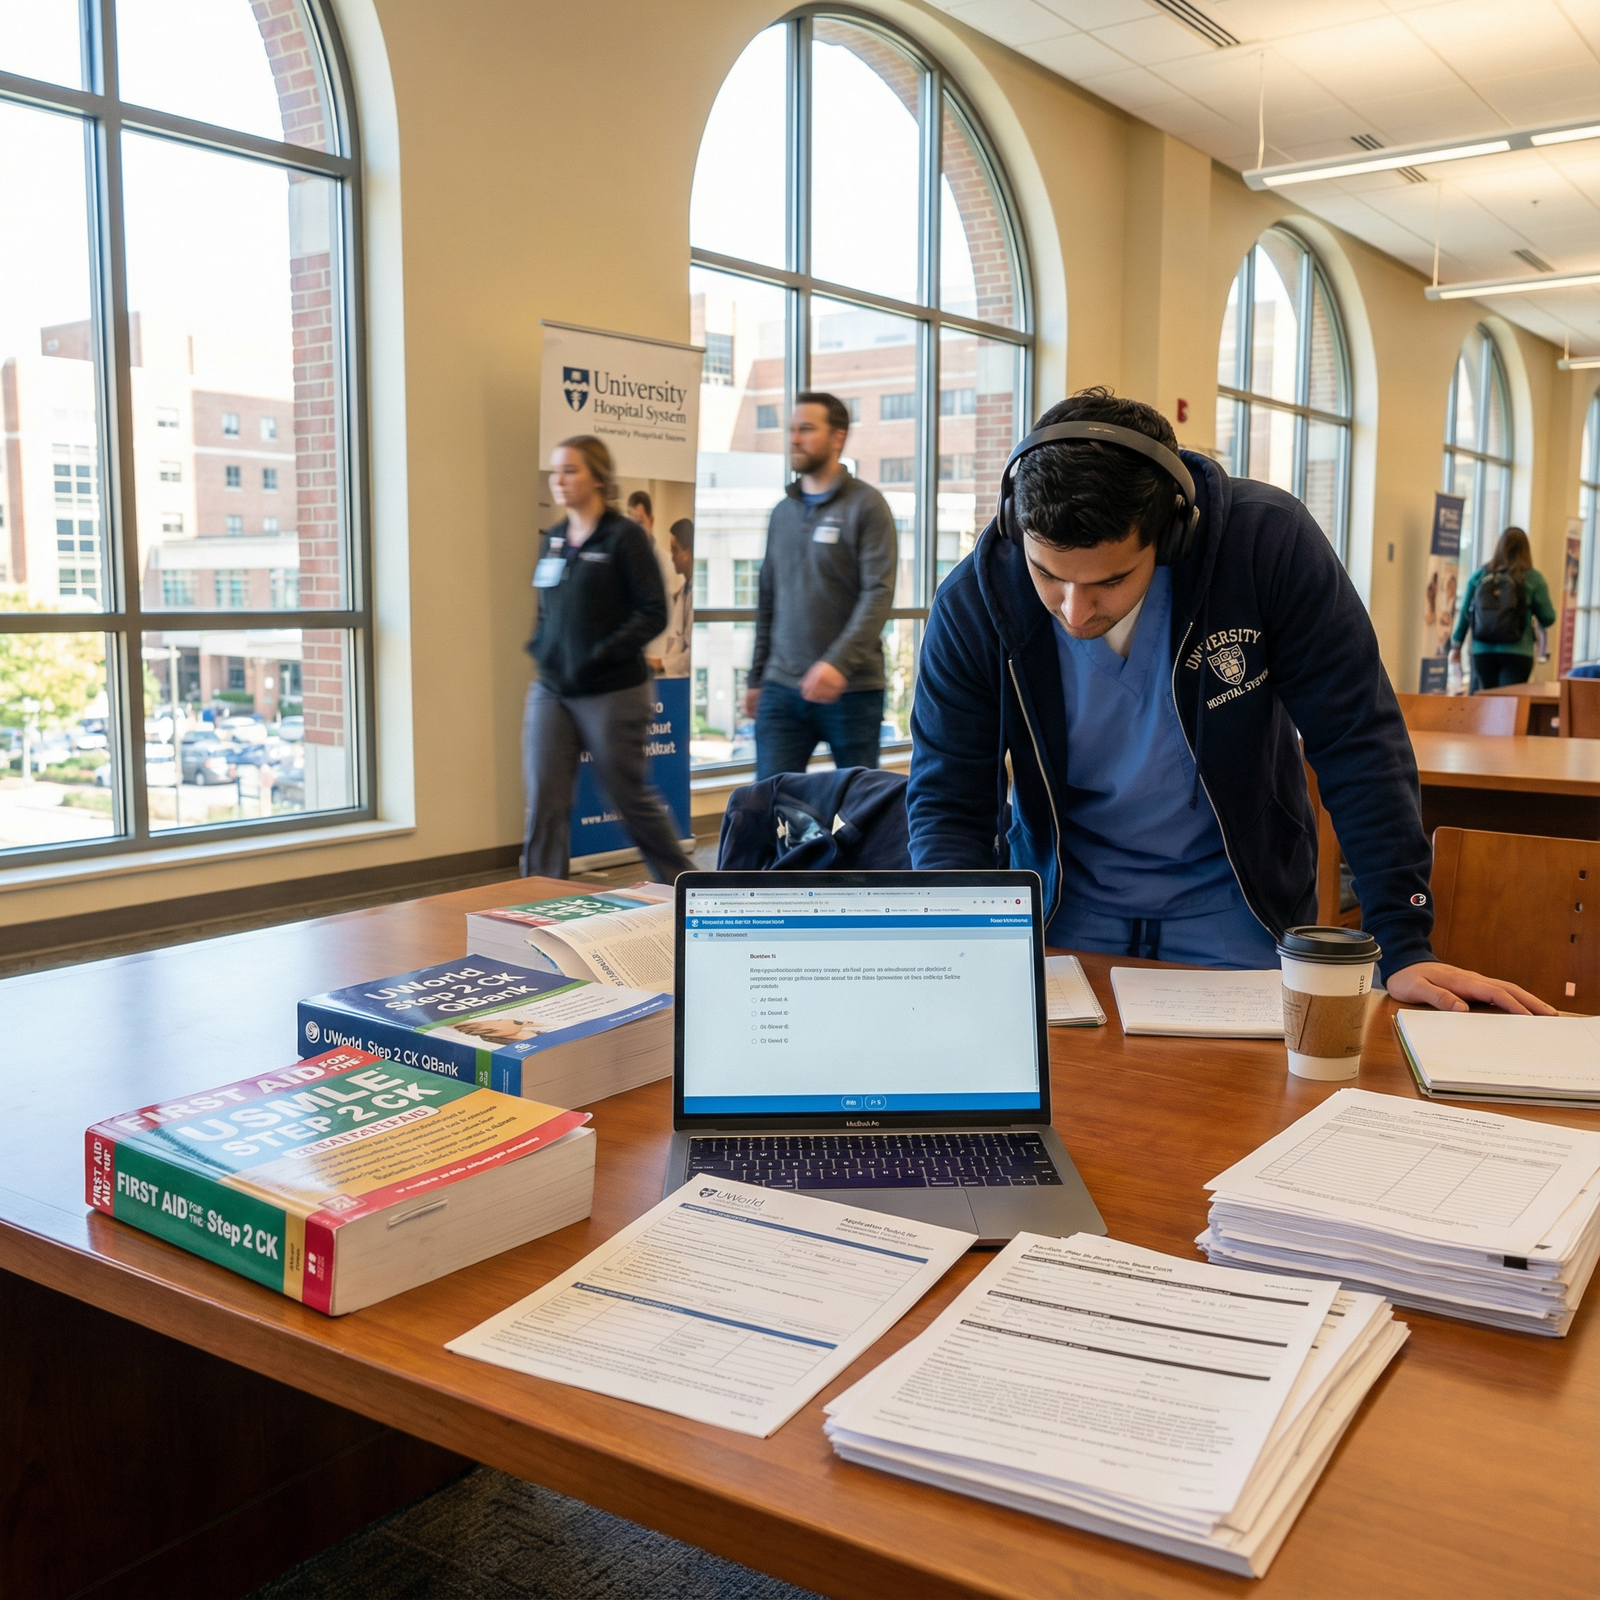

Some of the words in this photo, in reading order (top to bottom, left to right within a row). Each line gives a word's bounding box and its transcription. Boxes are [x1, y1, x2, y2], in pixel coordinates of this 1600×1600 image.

[594, 370, 688, 411] University
[594, 398, 644, 421] Hospital
[1206, 685, 1246, 710] HOSPITAL
[364, 967, 486, 1000] UWorld
[384, 991, 456, 1011] Step
[450, 984, 482, 994] 2
[477, 972, 528, 986] CK
[437, 984, 539, 1012] QBank
[323, 1028, 362, 1051] UWorld
[367, 1040, 392, 1060] Step
[393, 1047, 402, 1062] 2
[403, 1050, 419, 1067] CK
[421, 1055, 459, 1077] QBank
[115, 1088, 247, 1133] FIRST
[256, 1066, 325, 1094] AID
[176, 1069, 405, 1142] USMLE
[221, 1116, 332, 1156] STEP
[336, 1105, 379, 1122] 2
[371, 1082, 443, 1109] CK
[117, 1171, 160, 1207] FIRST
[161, 1191, 188, 1220] AID
[716, 1190, 766, 1207] UWorld
[207, 1209, 241, 1247] Step
[242, 1223, 254, 1249] 2
[255, 1230, 279, 1260] CK
